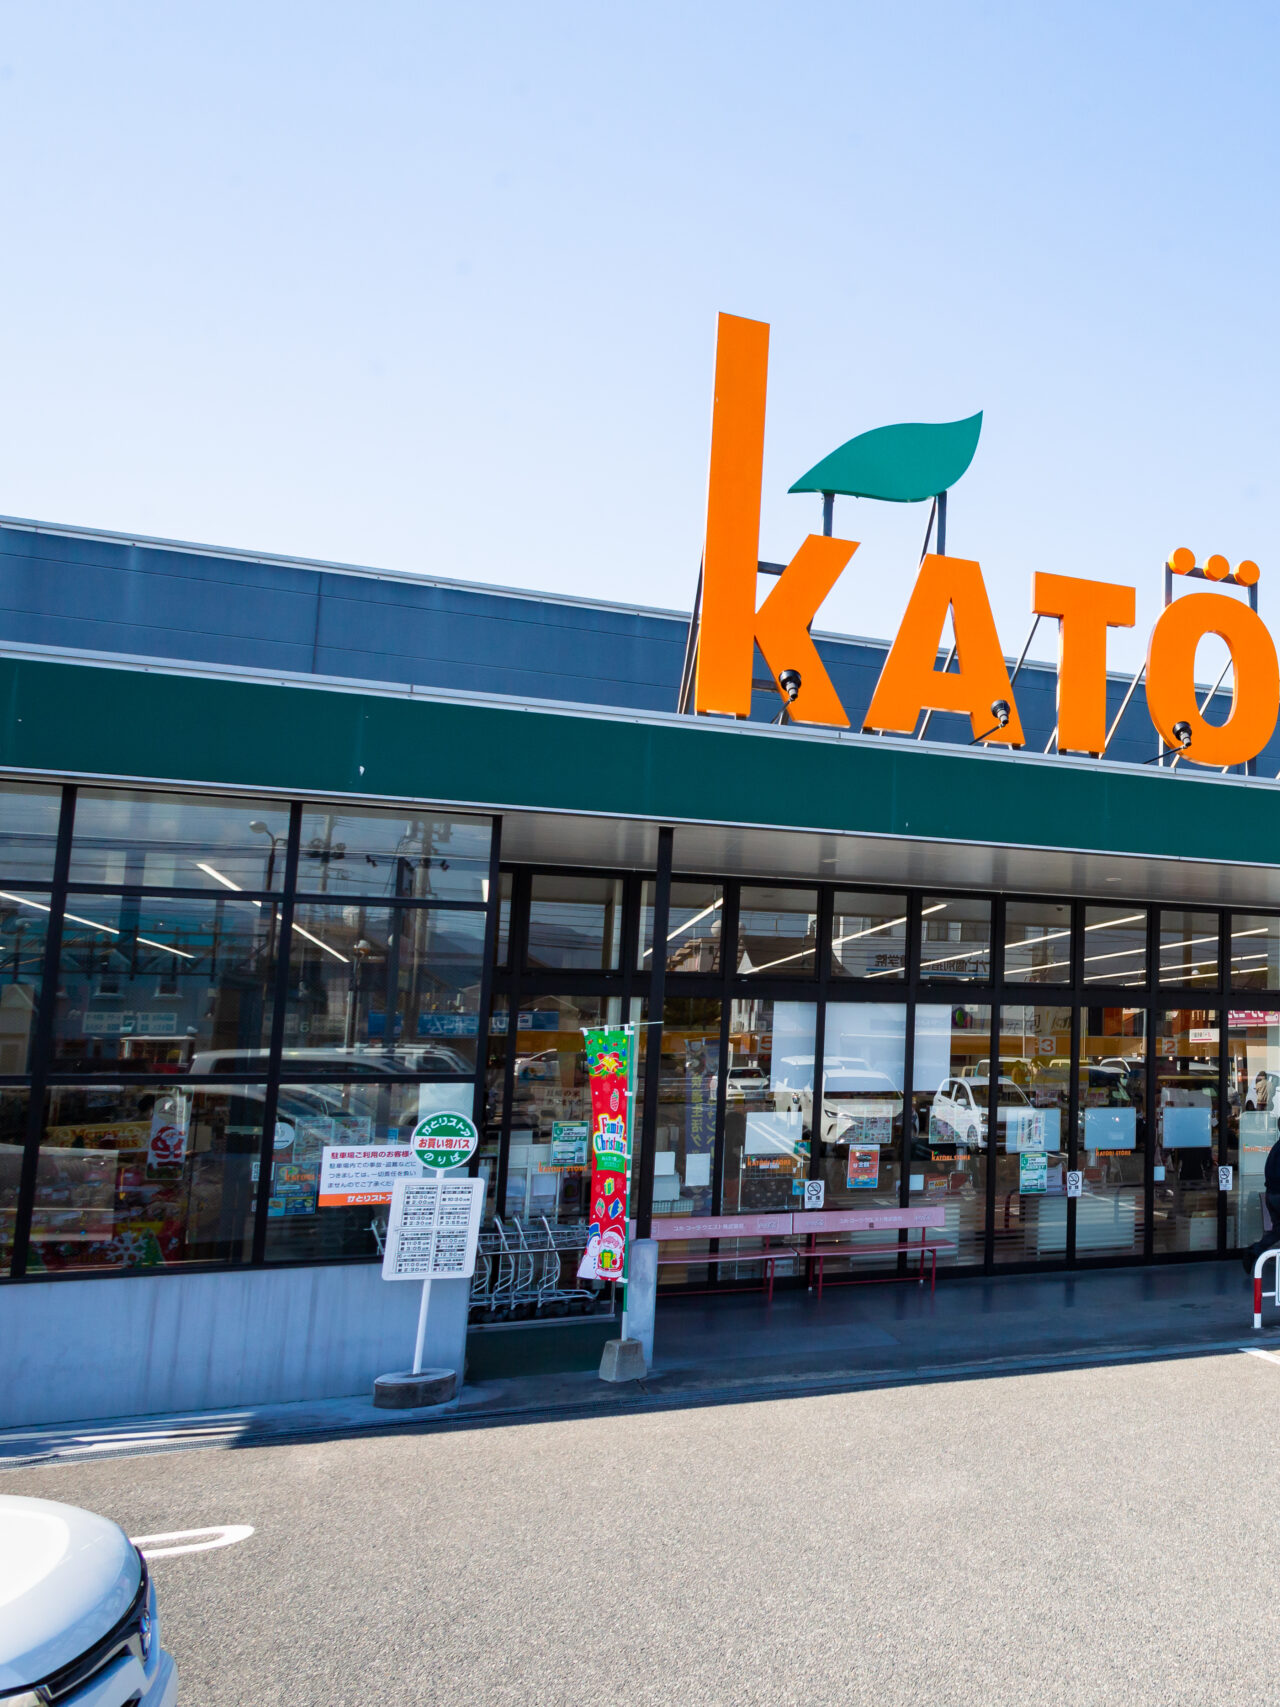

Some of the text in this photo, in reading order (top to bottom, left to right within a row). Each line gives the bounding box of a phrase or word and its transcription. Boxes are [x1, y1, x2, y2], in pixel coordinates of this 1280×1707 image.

[1041, 1038, 1054, 1053] 3
[1164, 1040, 1176, 1054] 2
[422, 1117, 472, 1137] かとりストア
[601, 1116, 624, 1138] Family
[418, 1138, 470, 1149] お買い物バス
[595, 1133, 626, 1155] Christmas
[424, 1152, 461, 1165] のりば
[327, 1180, 394, 1189] ませんのでご了承くだ
